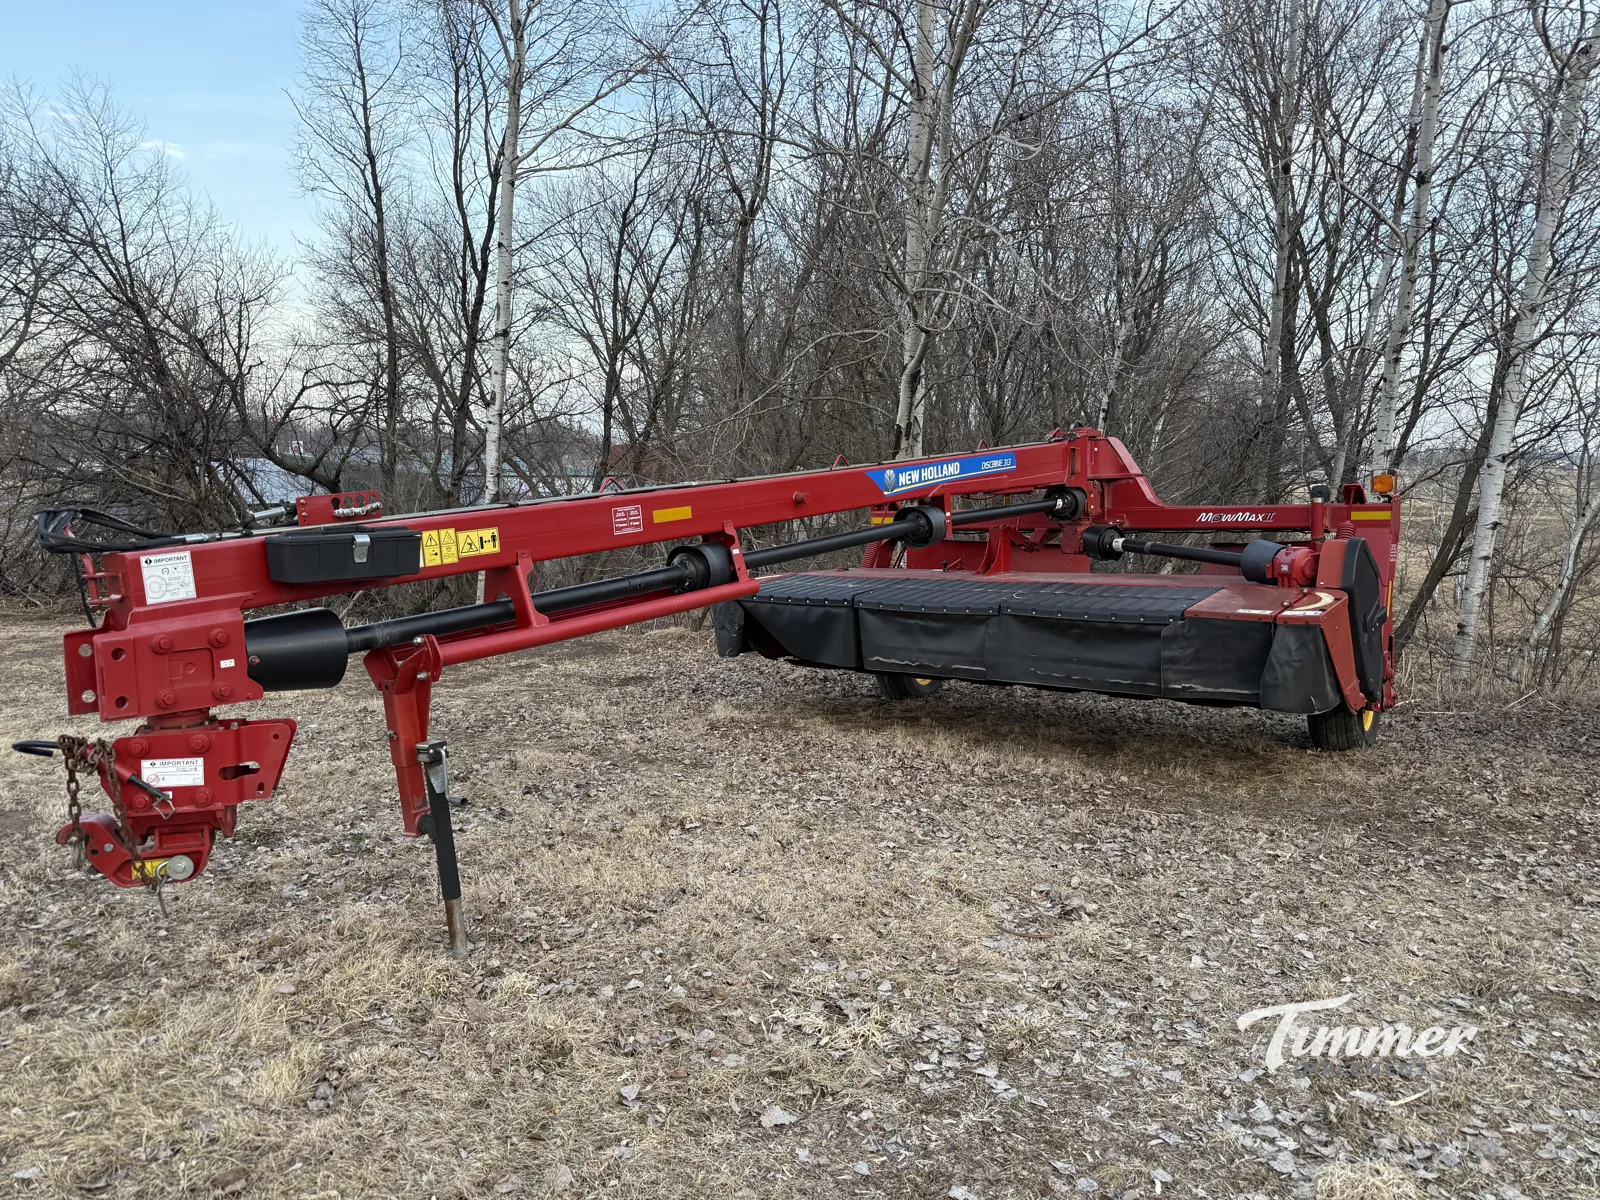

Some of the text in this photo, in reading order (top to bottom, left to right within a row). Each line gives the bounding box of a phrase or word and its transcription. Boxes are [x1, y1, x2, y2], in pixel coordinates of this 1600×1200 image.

[898, 462, 960, 486] NEW HOLLAND
[153, 555, 188, 564] IMPORTANT
